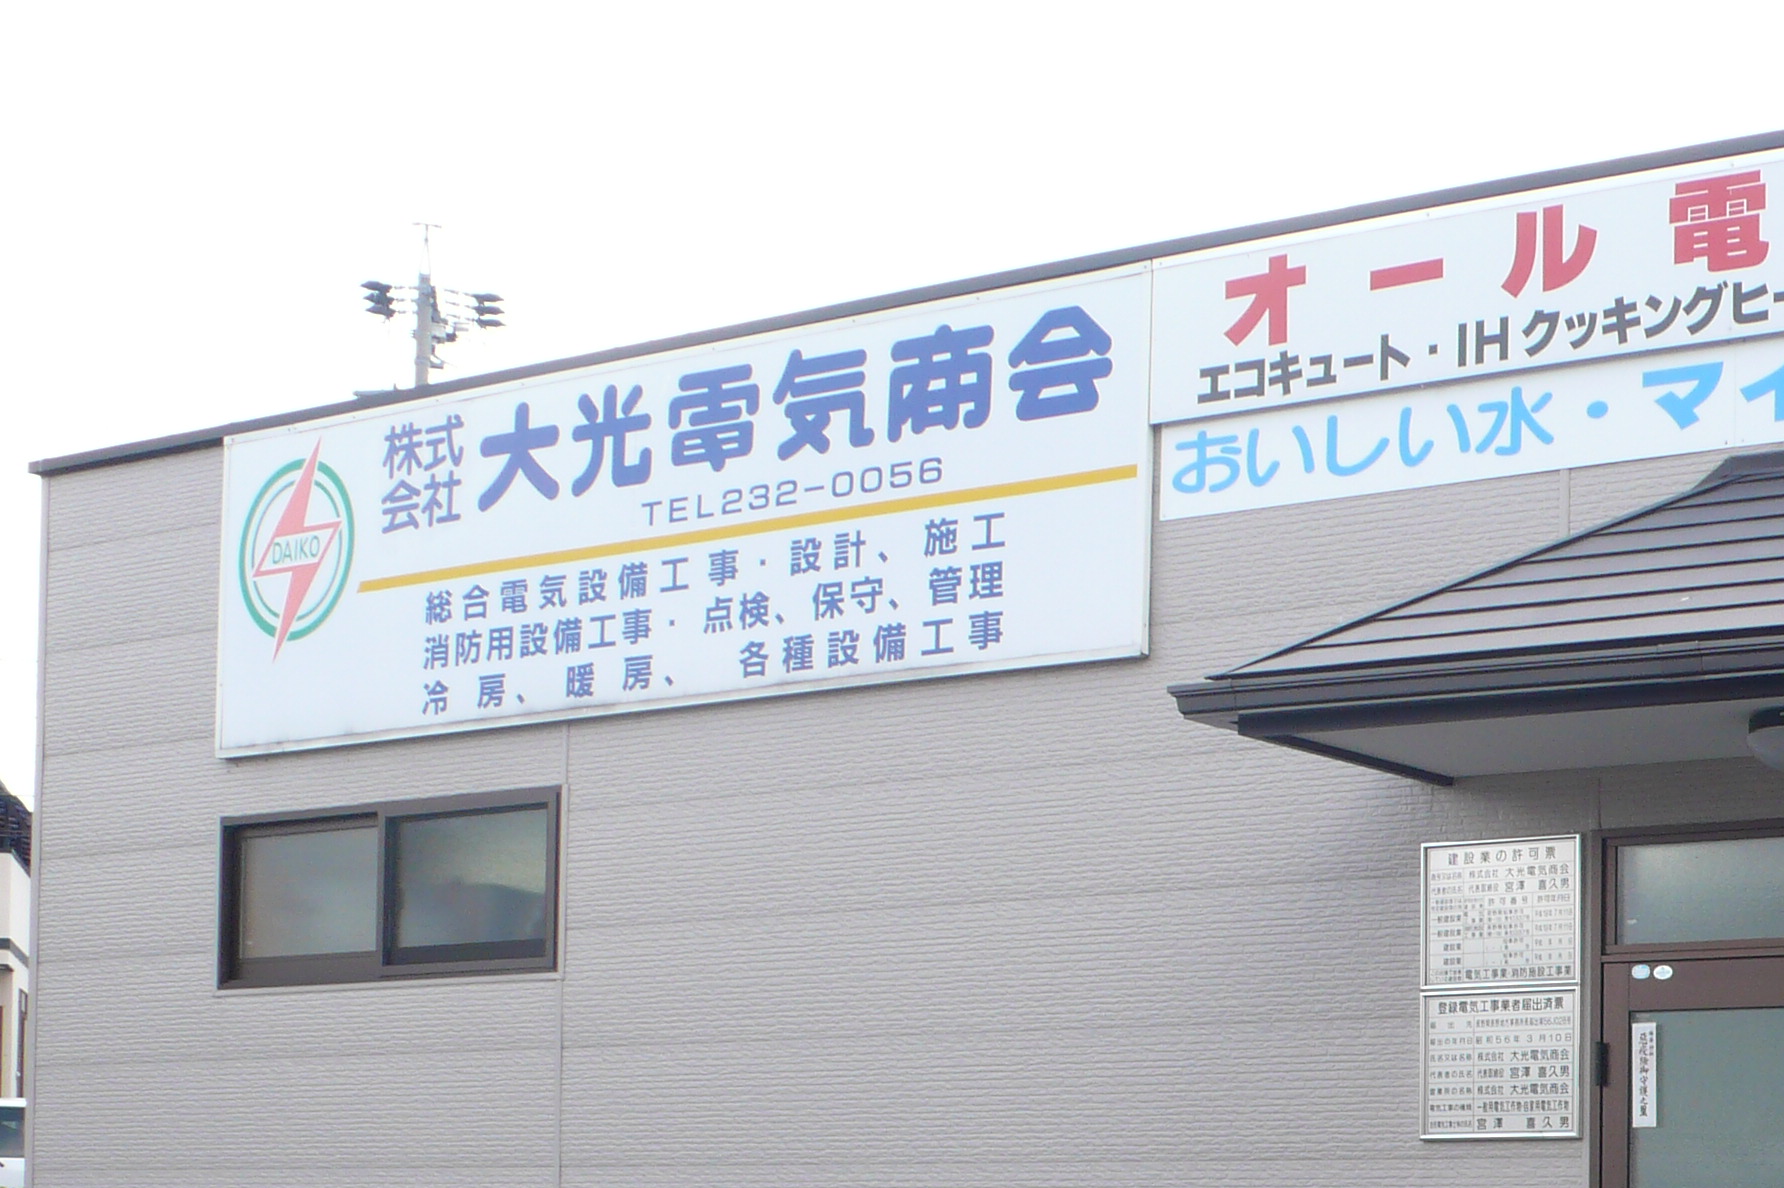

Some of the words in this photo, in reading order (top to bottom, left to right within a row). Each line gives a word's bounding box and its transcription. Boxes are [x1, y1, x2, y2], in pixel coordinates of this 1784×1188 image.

[476, 304, 1114, 511] 大光電気商会
[271, 535, 321, 566] DAIKO
[1448, 846, 1557, 865] 建設業の許可票
[1505, 863, 1569, 877] 大光電気商会
[1510, 1049, 1570, 1061] 大光電気商会
[1510, 1083, 1570, 1095] 大光電気商会
